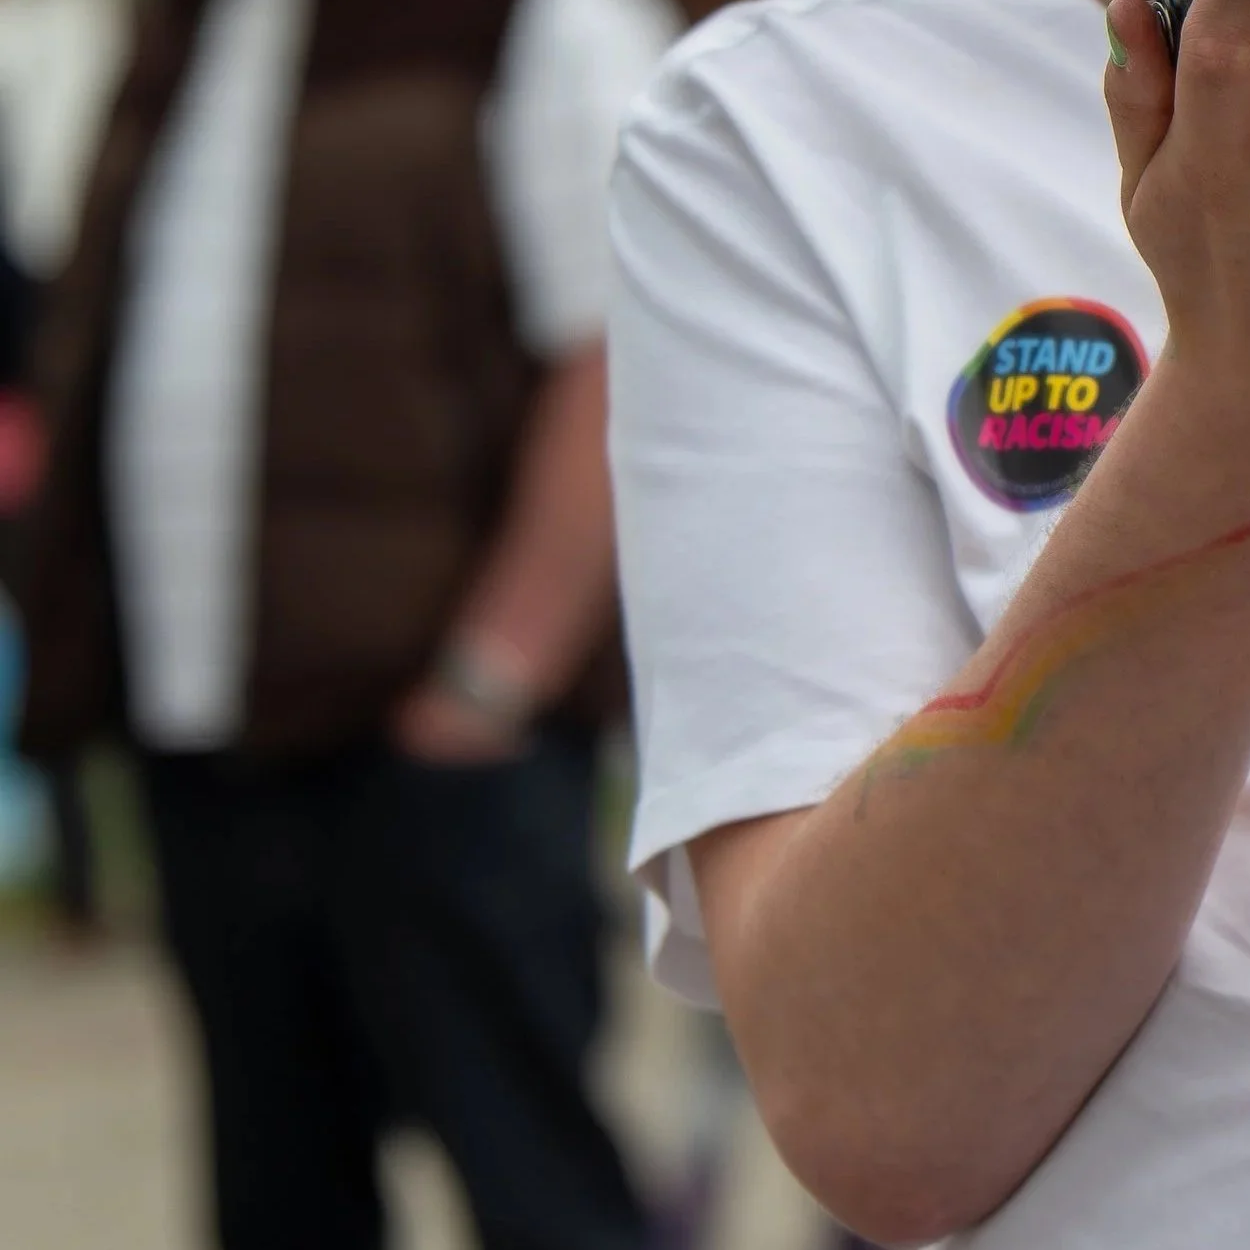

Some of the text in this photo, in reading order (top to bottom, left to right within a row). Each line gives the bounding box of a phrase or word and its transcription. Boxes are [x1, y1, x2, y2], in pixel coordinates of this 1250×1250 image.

[993, 337, 1117, 375] STAND
[988, 375, 1099, 413] UP TO
